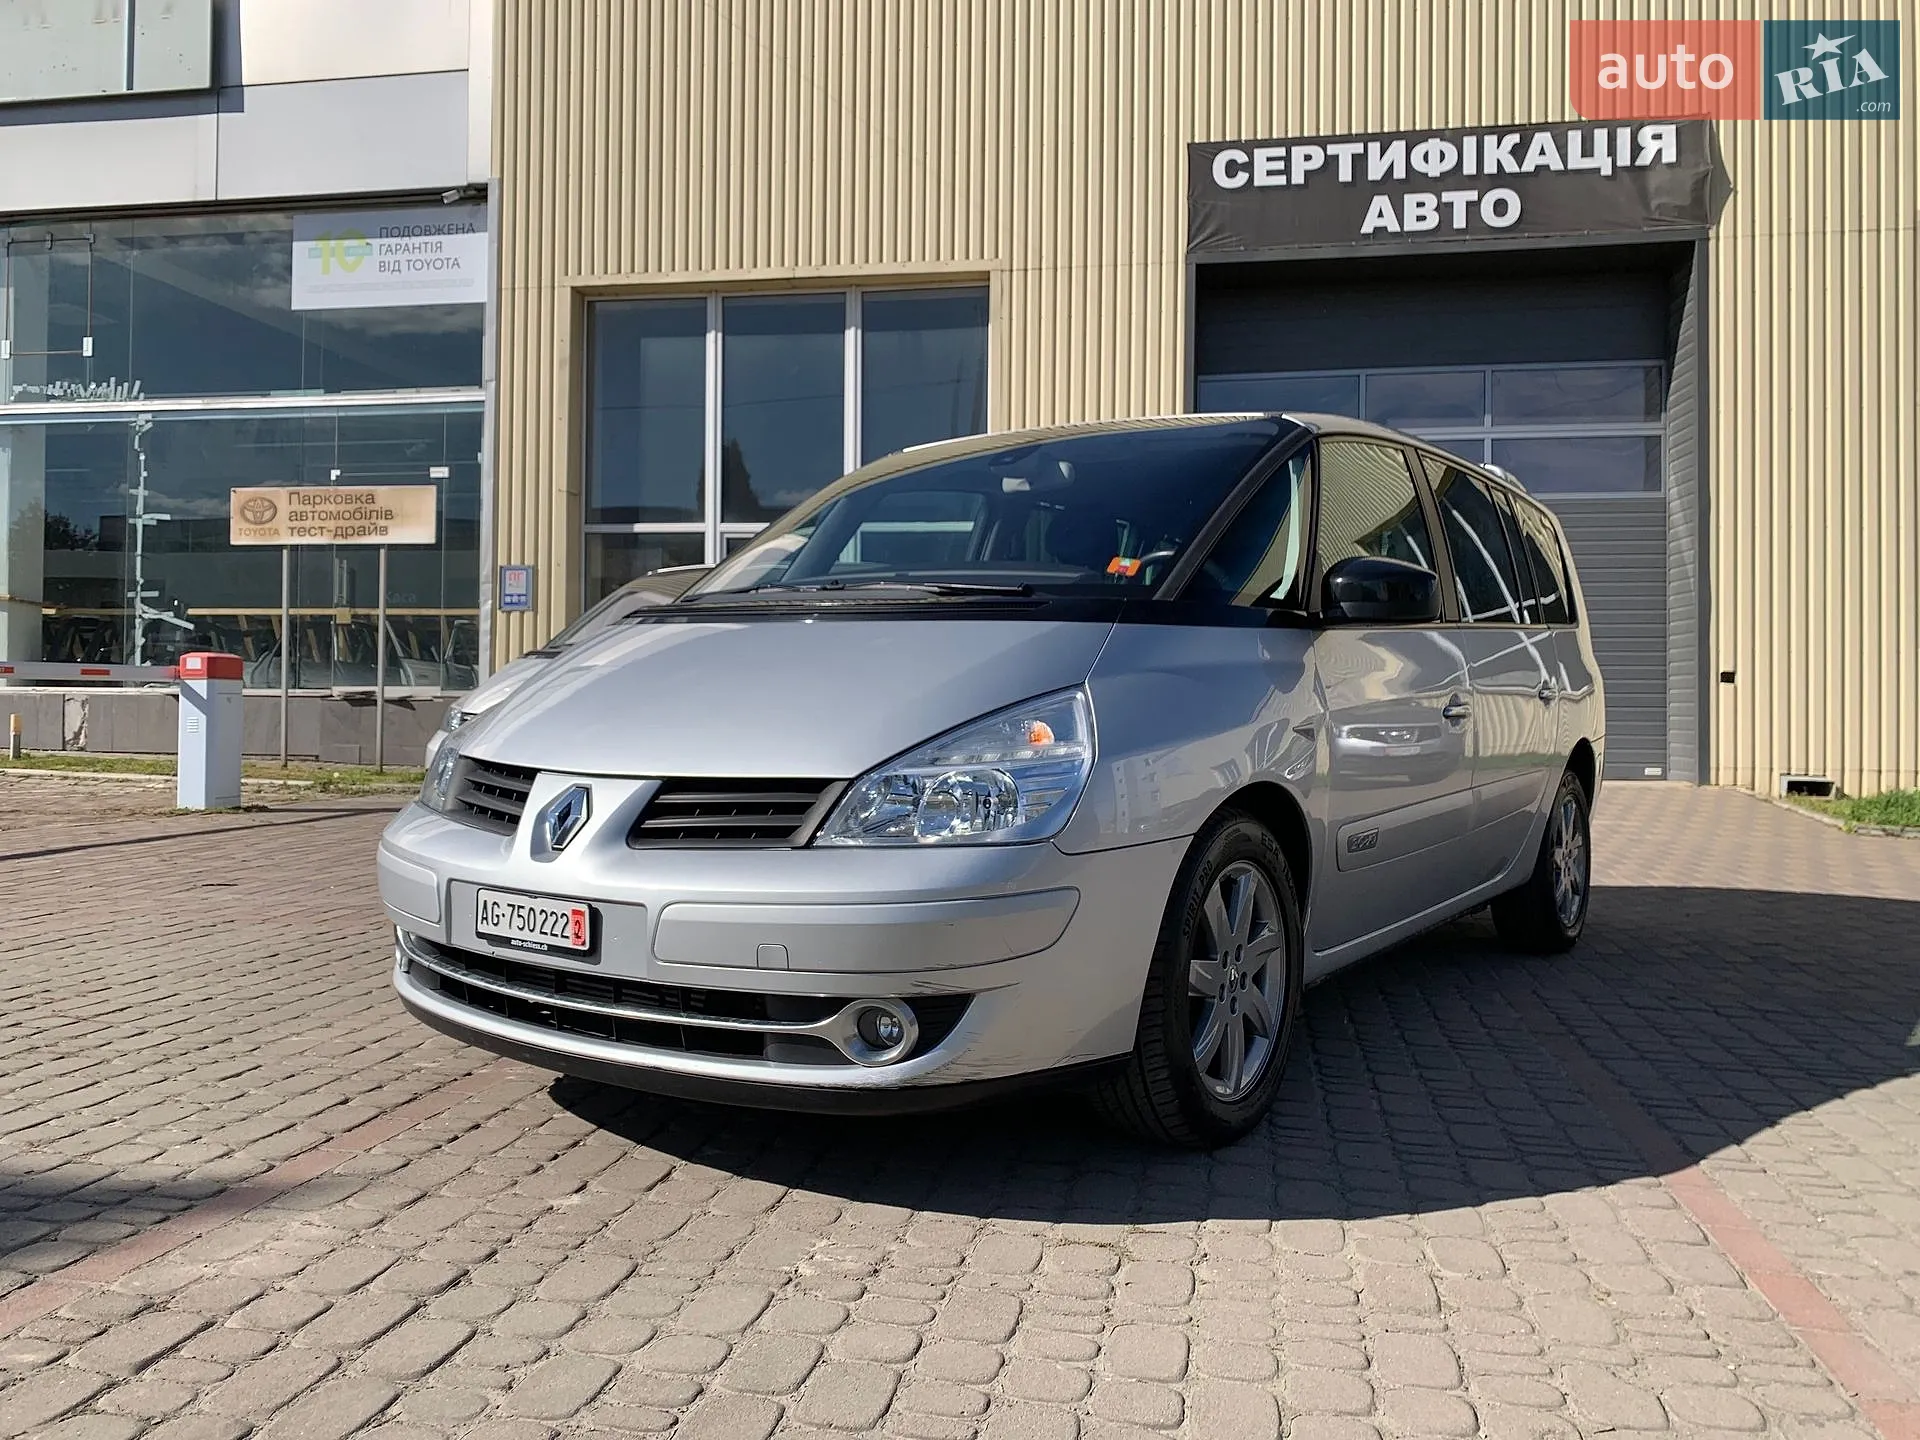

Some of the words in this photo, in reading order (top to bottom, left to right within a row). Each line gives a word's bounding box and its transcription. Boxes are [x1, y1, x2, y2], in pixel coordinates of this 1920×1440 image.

[1211, 123, 1679, 190] СЕРТИФІКАЦІЯ
[1360, 188, 1522, 235] АВТО
[379, 222, 476, 240] ПОДОВЖЕНА
[378, 240, 443, 257] ГАРАНТІЯ
[378, 259, 402, 275] ВІД
[405, 257, 461, 272] TOYOTA
[287, 491, 376, 507] Парковка
[288, 506, 394, 522] автомобілів
[238, 527, 281, 537] TOYOTA
[288, 522, 389, 540] тест-драйв
